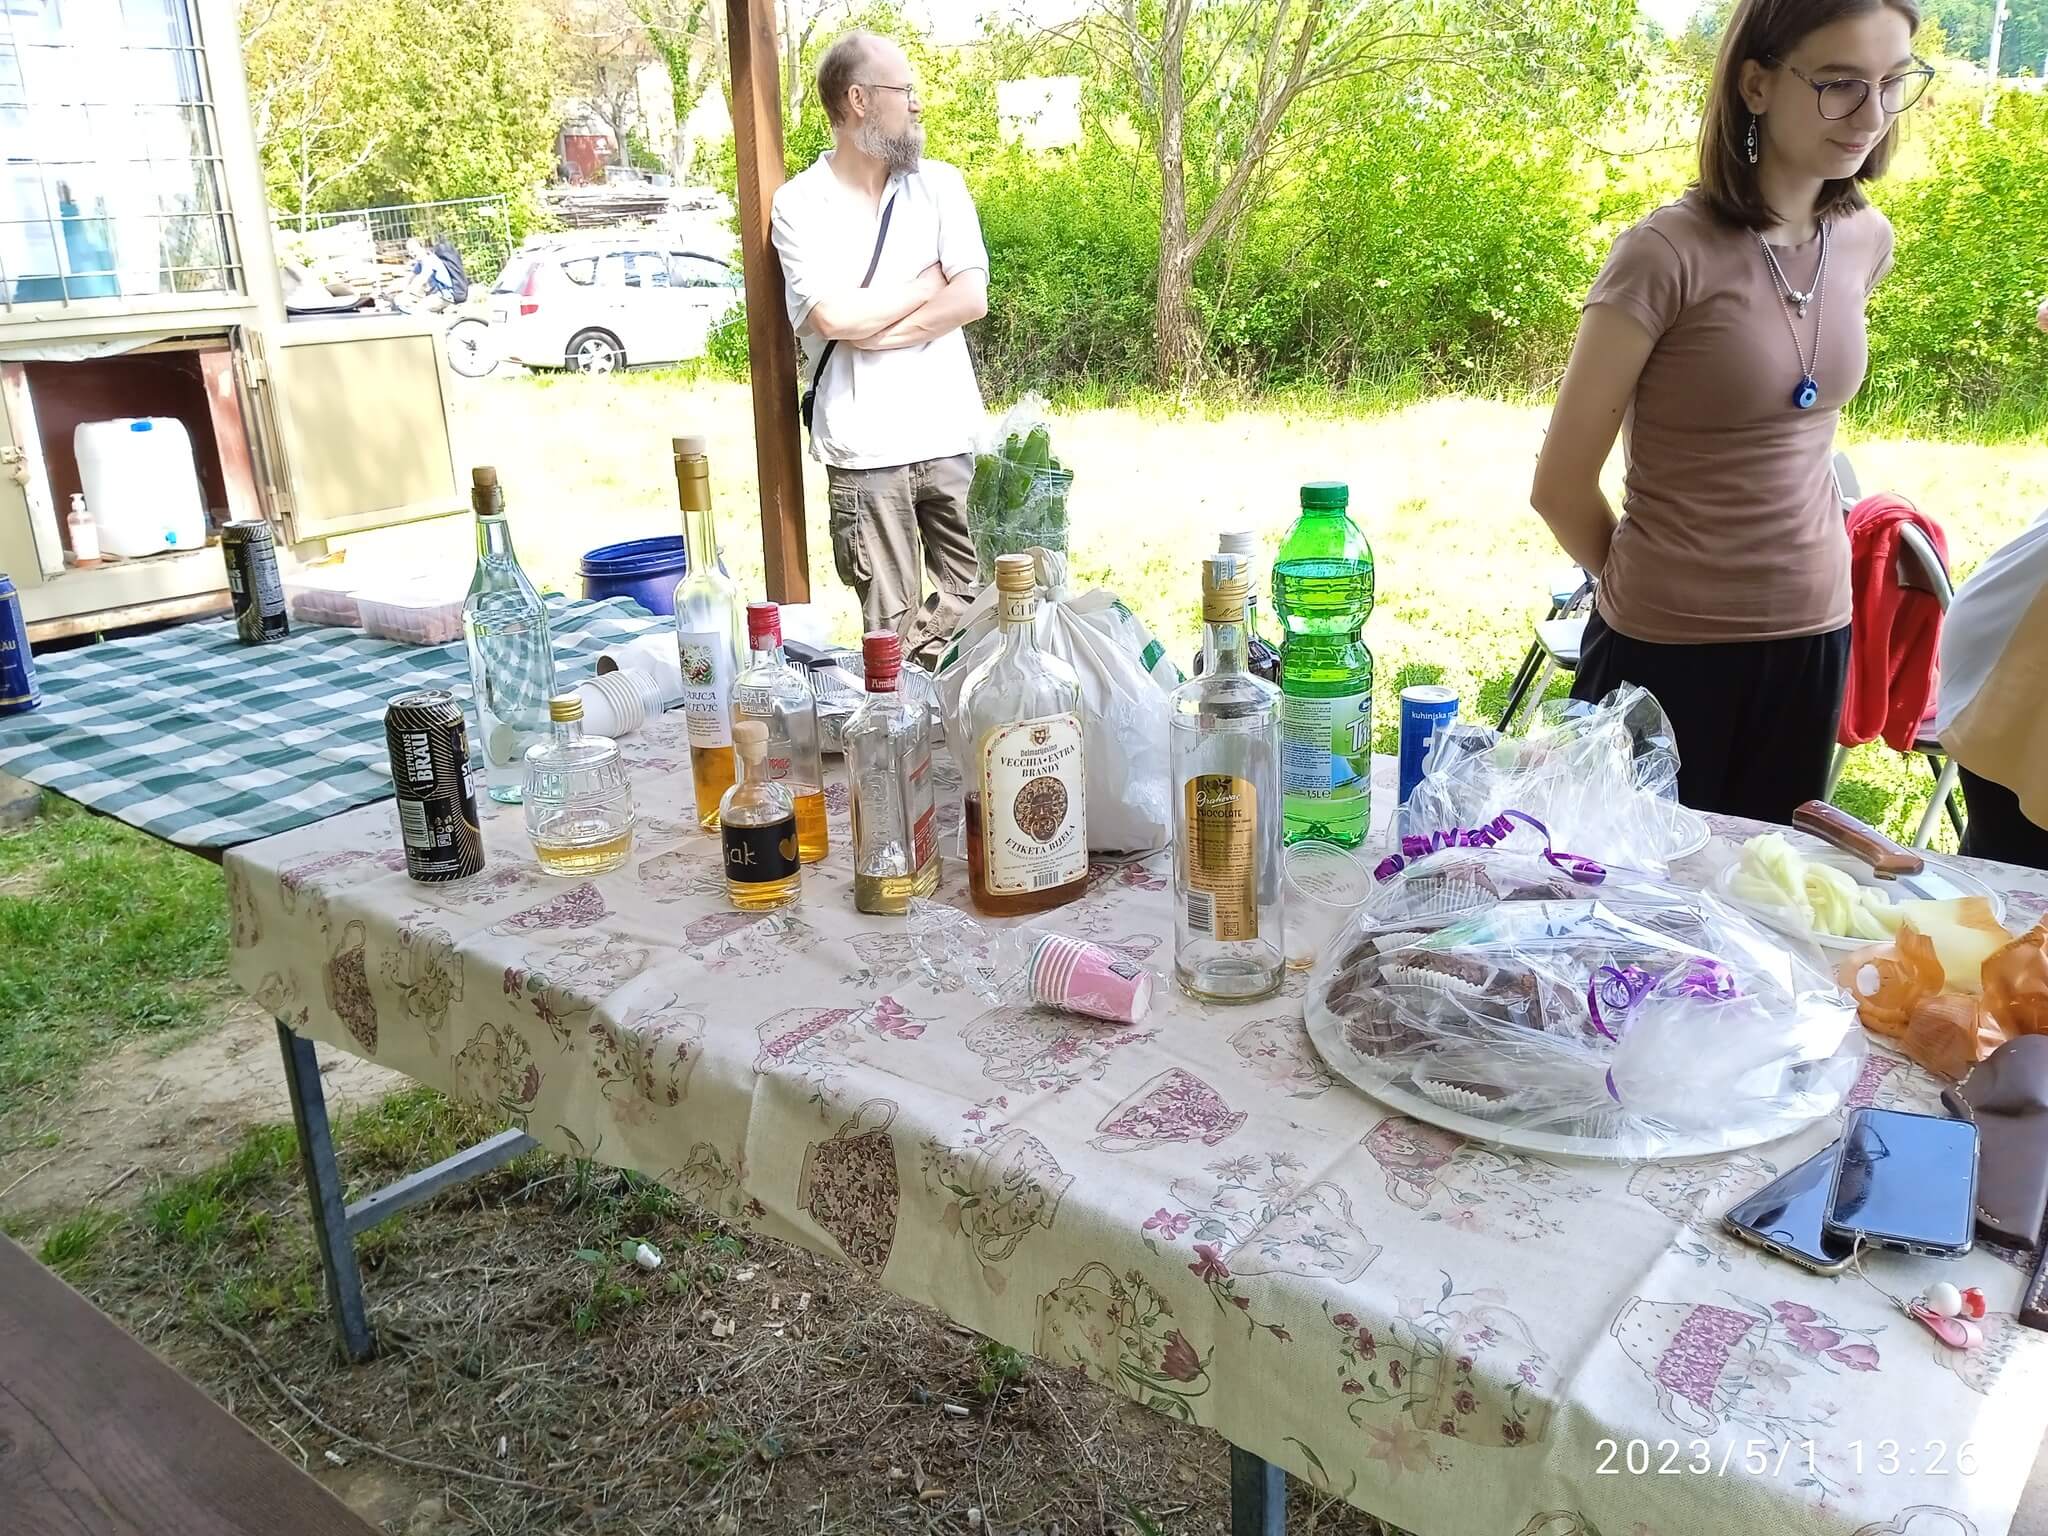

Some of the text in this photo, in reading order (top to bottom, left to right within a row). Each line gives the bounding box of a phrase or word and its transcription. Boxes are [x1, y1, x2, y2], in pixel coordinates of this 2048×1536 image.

[741, 689, 769, 704] BAR
[1411, 711, 1447, 720] kuhinjska
[402, 733, 417, 782] STEPHANS
[411, 733, 434, 781] BRÄU
[1022, 763, 1060, 778] BRANDY
[1197, 809, 1242, 818] CHOCOLATE
[1005, 825, 1075, 855] ETIKETA BIJELA
